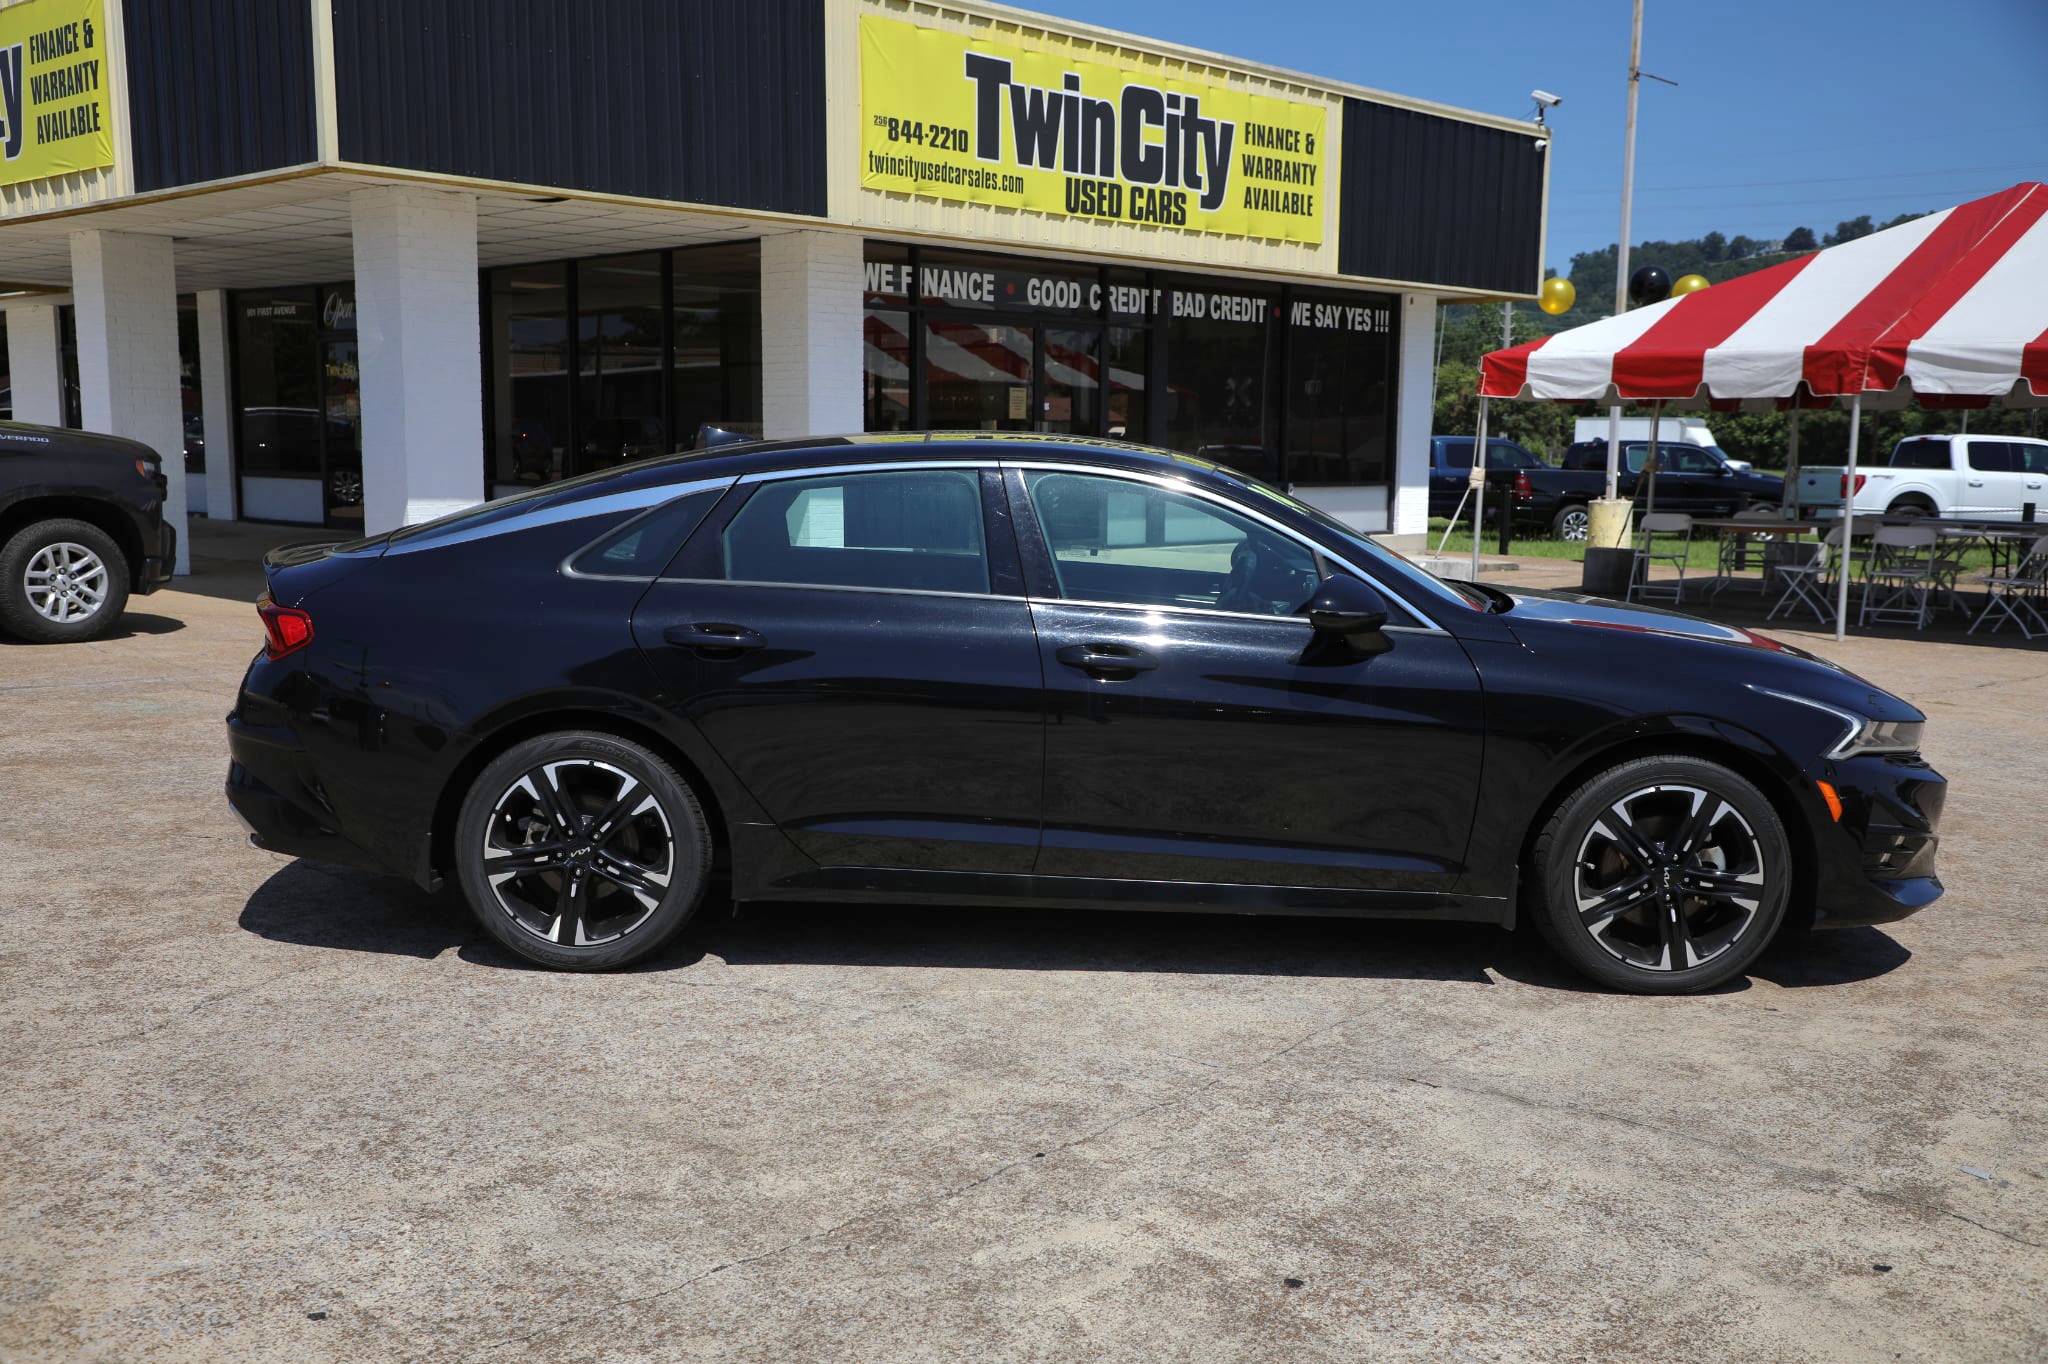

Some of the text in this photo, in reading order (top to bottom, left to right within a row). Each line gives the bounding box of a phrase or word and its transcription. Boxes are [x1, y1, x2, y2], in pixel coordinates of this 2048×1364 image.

[29, 18, 94, 65] FINANCE &
[30, 59, 99, 105] WARRANTY
[0, 43, 23, 162] y
[37, 102, 101, 145] AVAILABLE
[874, 114, 888, 127] 256
[1244, 121, 1315, 155] FINANCE &
[869, 150, 1024, 194] twincityusedcarsales.com
[1242, 153, 1317, 186] WARRANTY
[1065, 177, 1187, 226] USED CARS
[1243, 186, 1314, 217] AVAILABLE
[863, 262, 894, 293] WE
[1027, 277, 1082, 309] GOOD
[323, 291, 355, 328] Open
[1172, 290, 1267, 323] BAD CREDIT
[1314, 303, 1342, 329] SAY
[1345, 306, 1372, 332] YES
[1375, 309, 1390, 333] !!!
